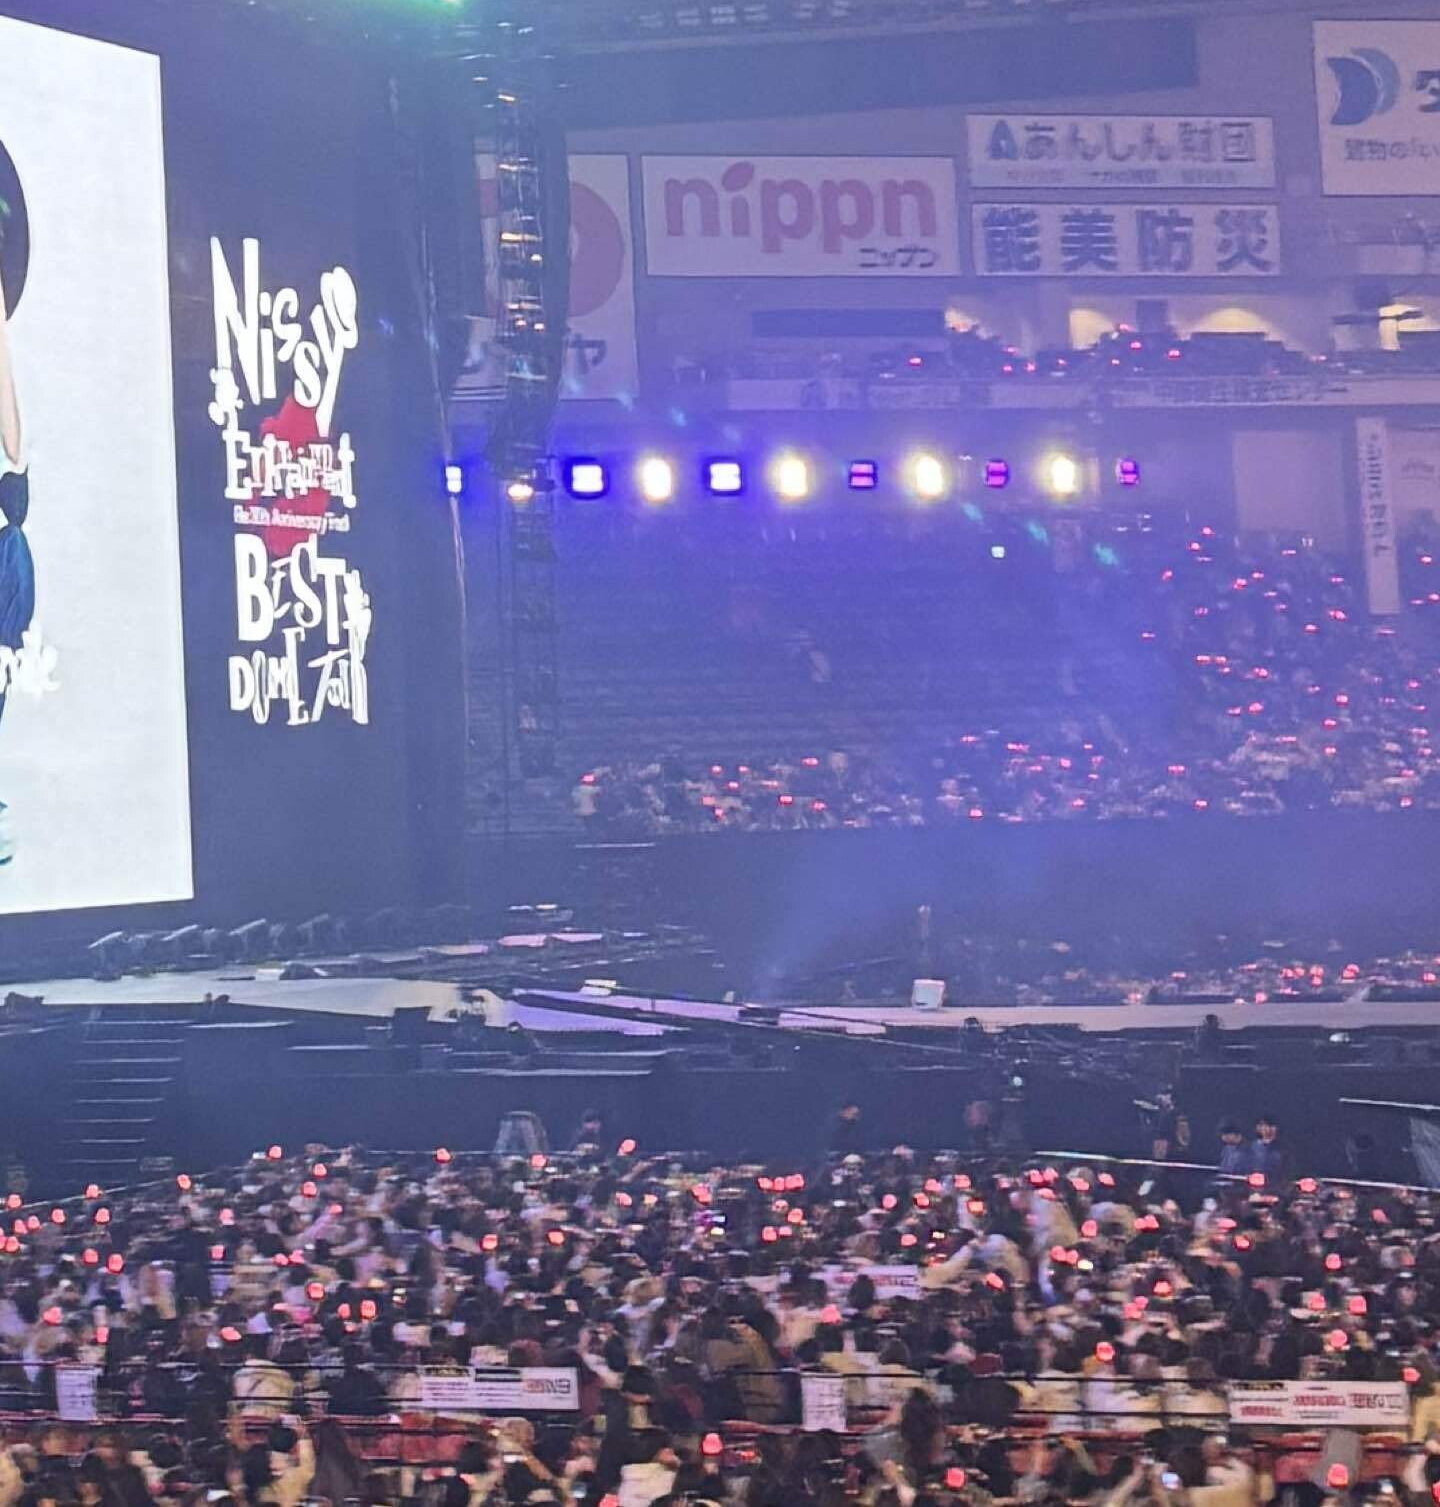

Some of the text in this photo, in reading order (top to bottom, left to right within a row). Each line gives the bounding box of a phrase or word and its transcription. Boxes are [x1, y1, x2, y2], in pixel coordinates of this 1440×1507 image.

[1024, 119, 1257, 163] あんしん財団
[665, 161, 937, 254] nippn
[983, 207, 1272, 272] 能美防災
[858, 246, 940, 269] ニップン
[210, 236, 359, 438] Nissy
[235, 533, 347, 645] BEST
[229, 624, 369, 726] DOME TOUR
